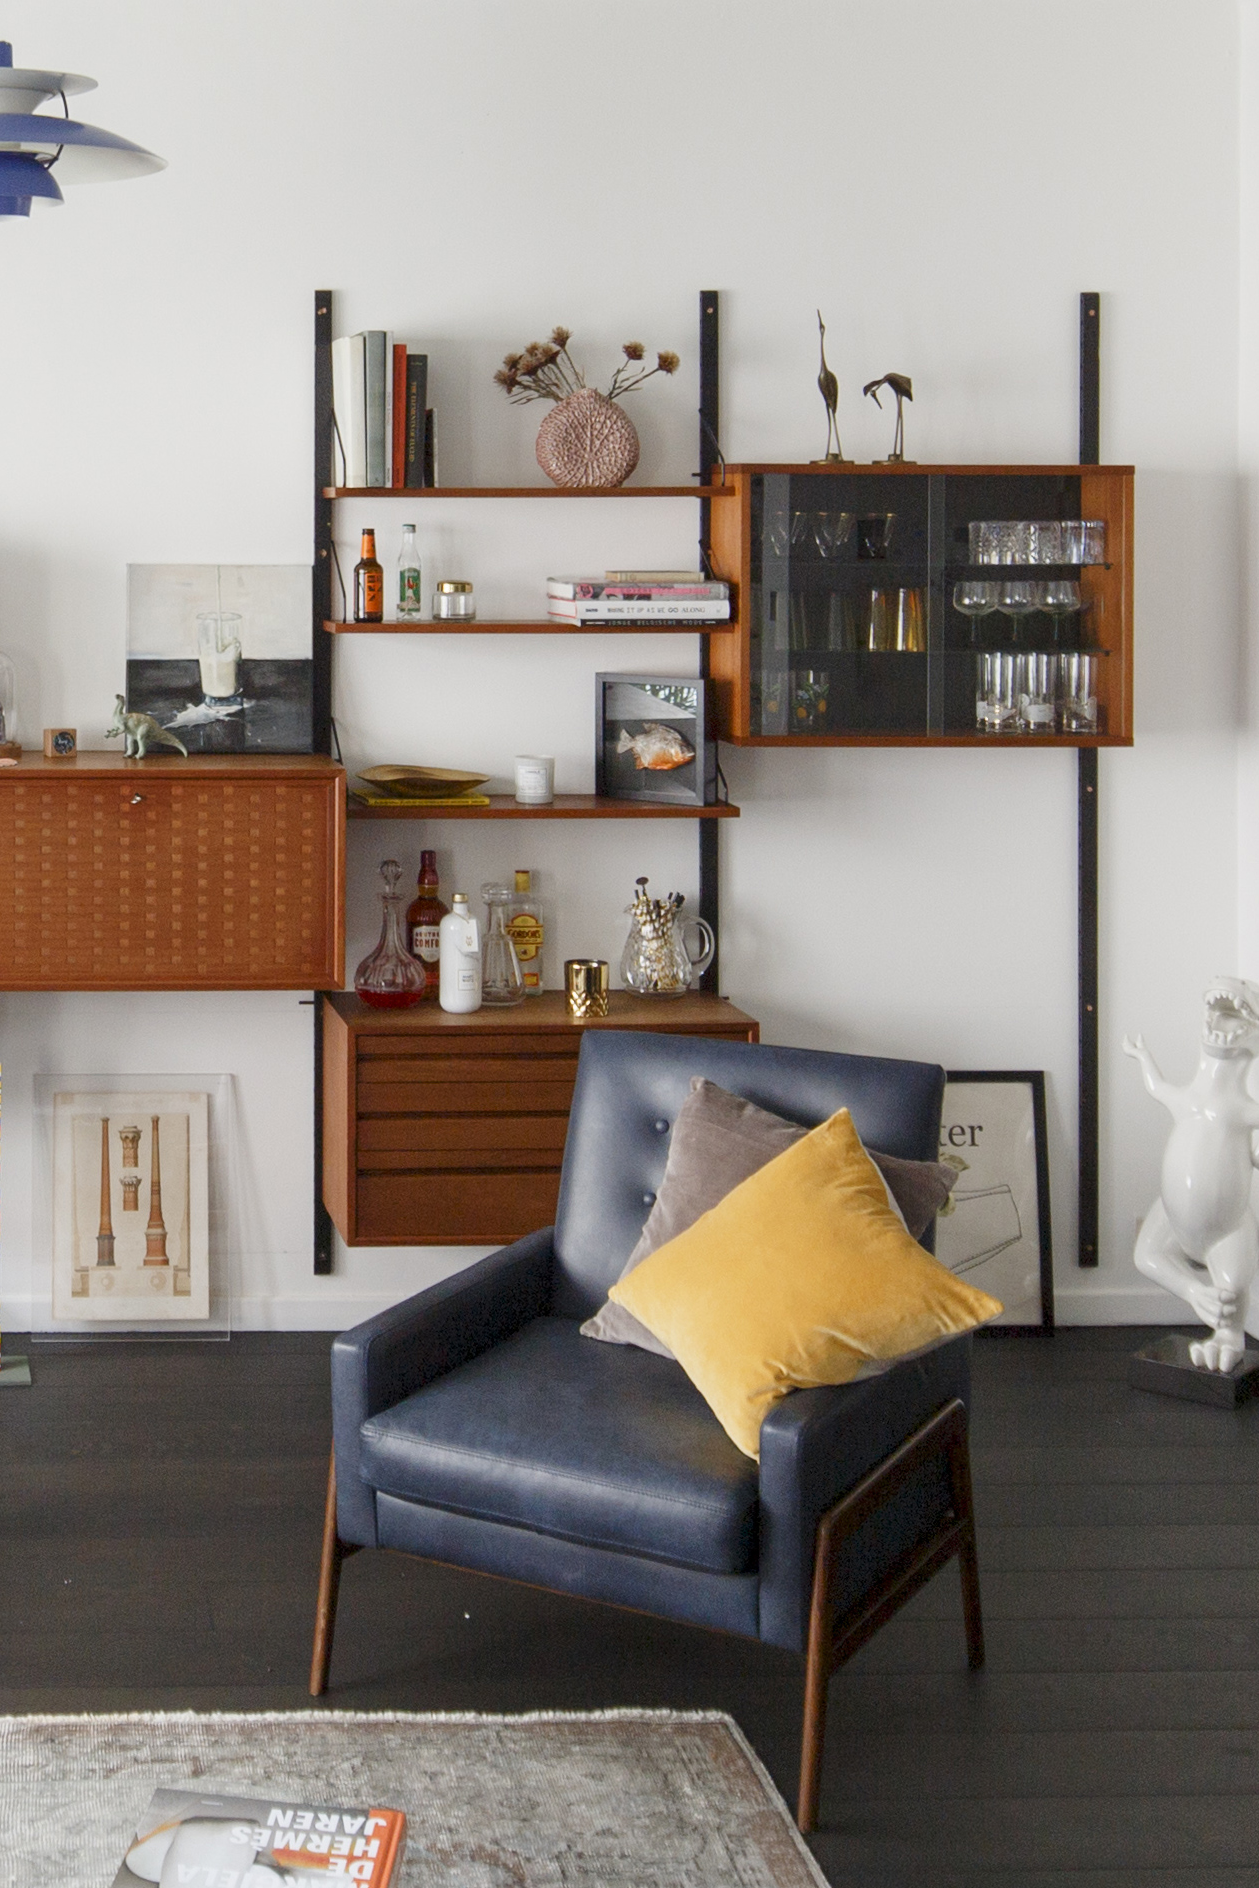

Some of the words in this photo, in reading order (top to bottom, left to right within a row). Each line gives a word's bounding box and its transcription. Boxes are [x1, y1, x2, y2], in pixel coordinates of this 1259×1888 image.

[267, 1807, 387, 1836] JAREN
[229, 1825, 380, 1858] HERMÈS
[328, 1857, 376, 1880] DE
